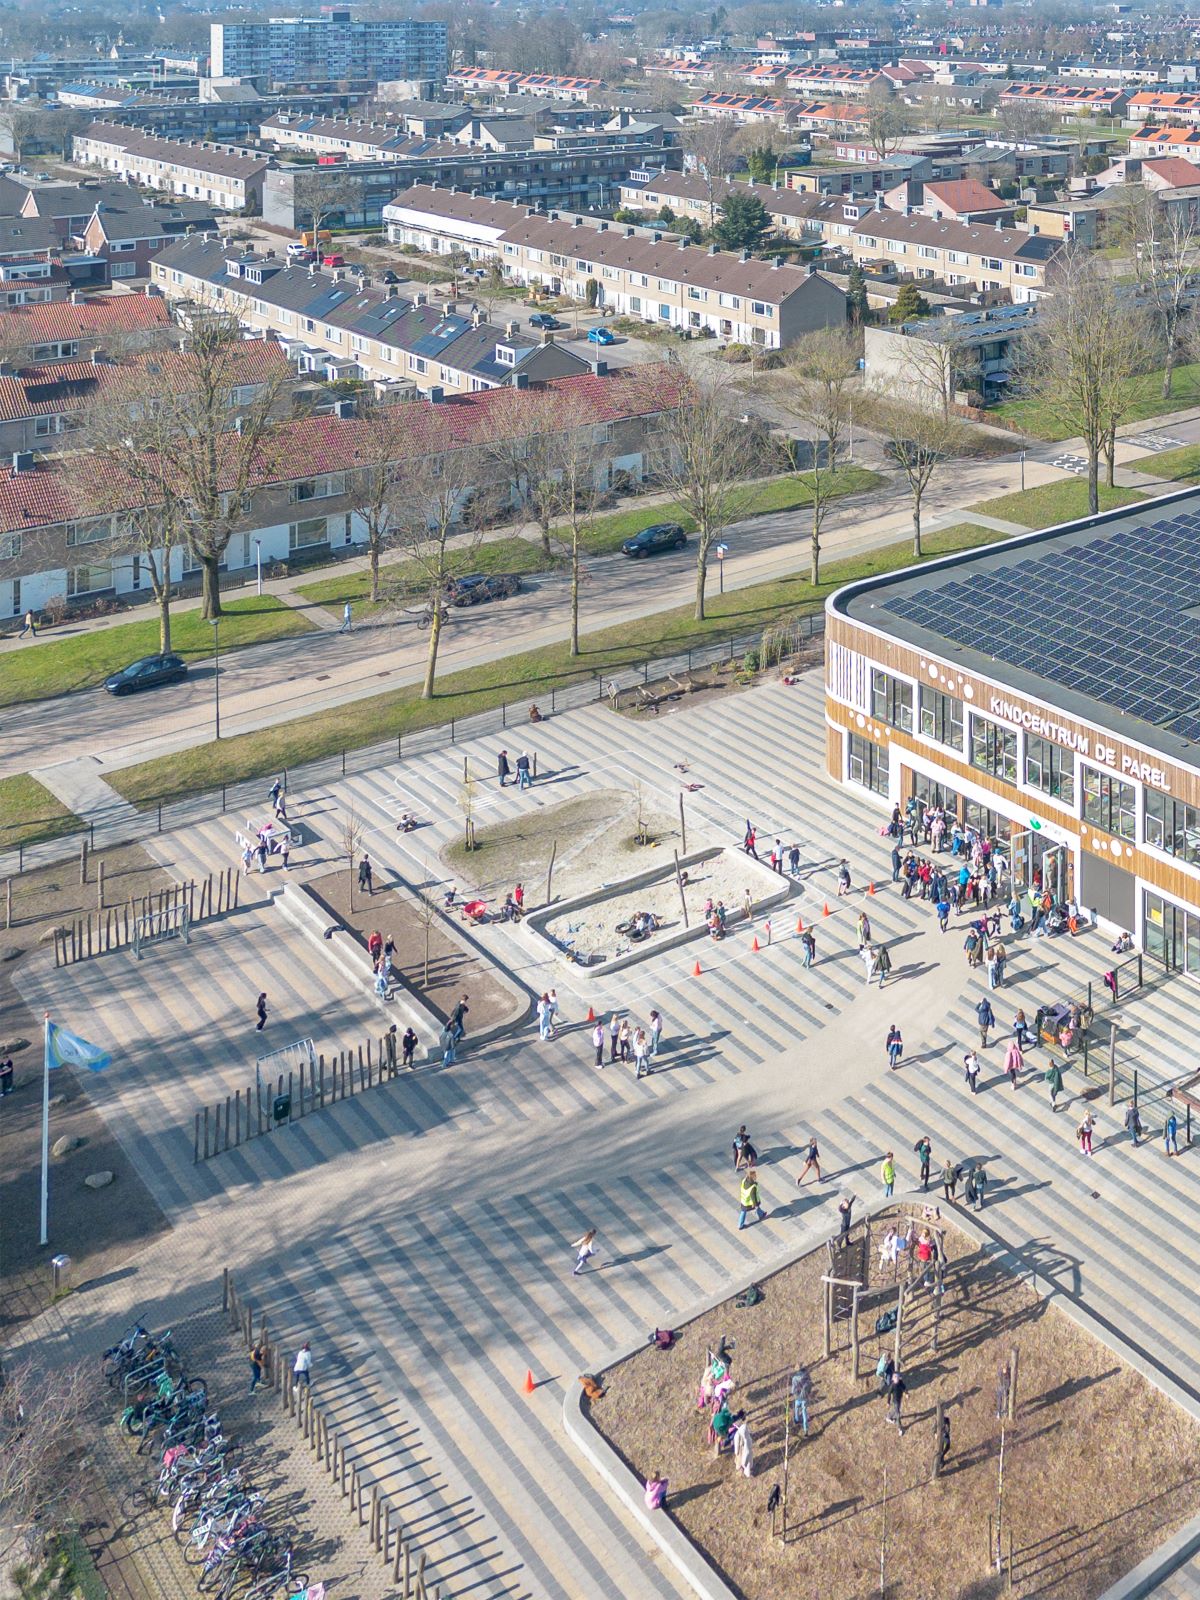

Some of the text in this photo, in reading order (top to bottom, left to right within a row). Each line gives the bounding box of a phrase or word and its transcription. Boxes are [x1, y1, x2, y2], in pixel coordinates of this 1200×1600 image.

[990, 696, 1171, 791] KINDCENTRUM DE PAREL
